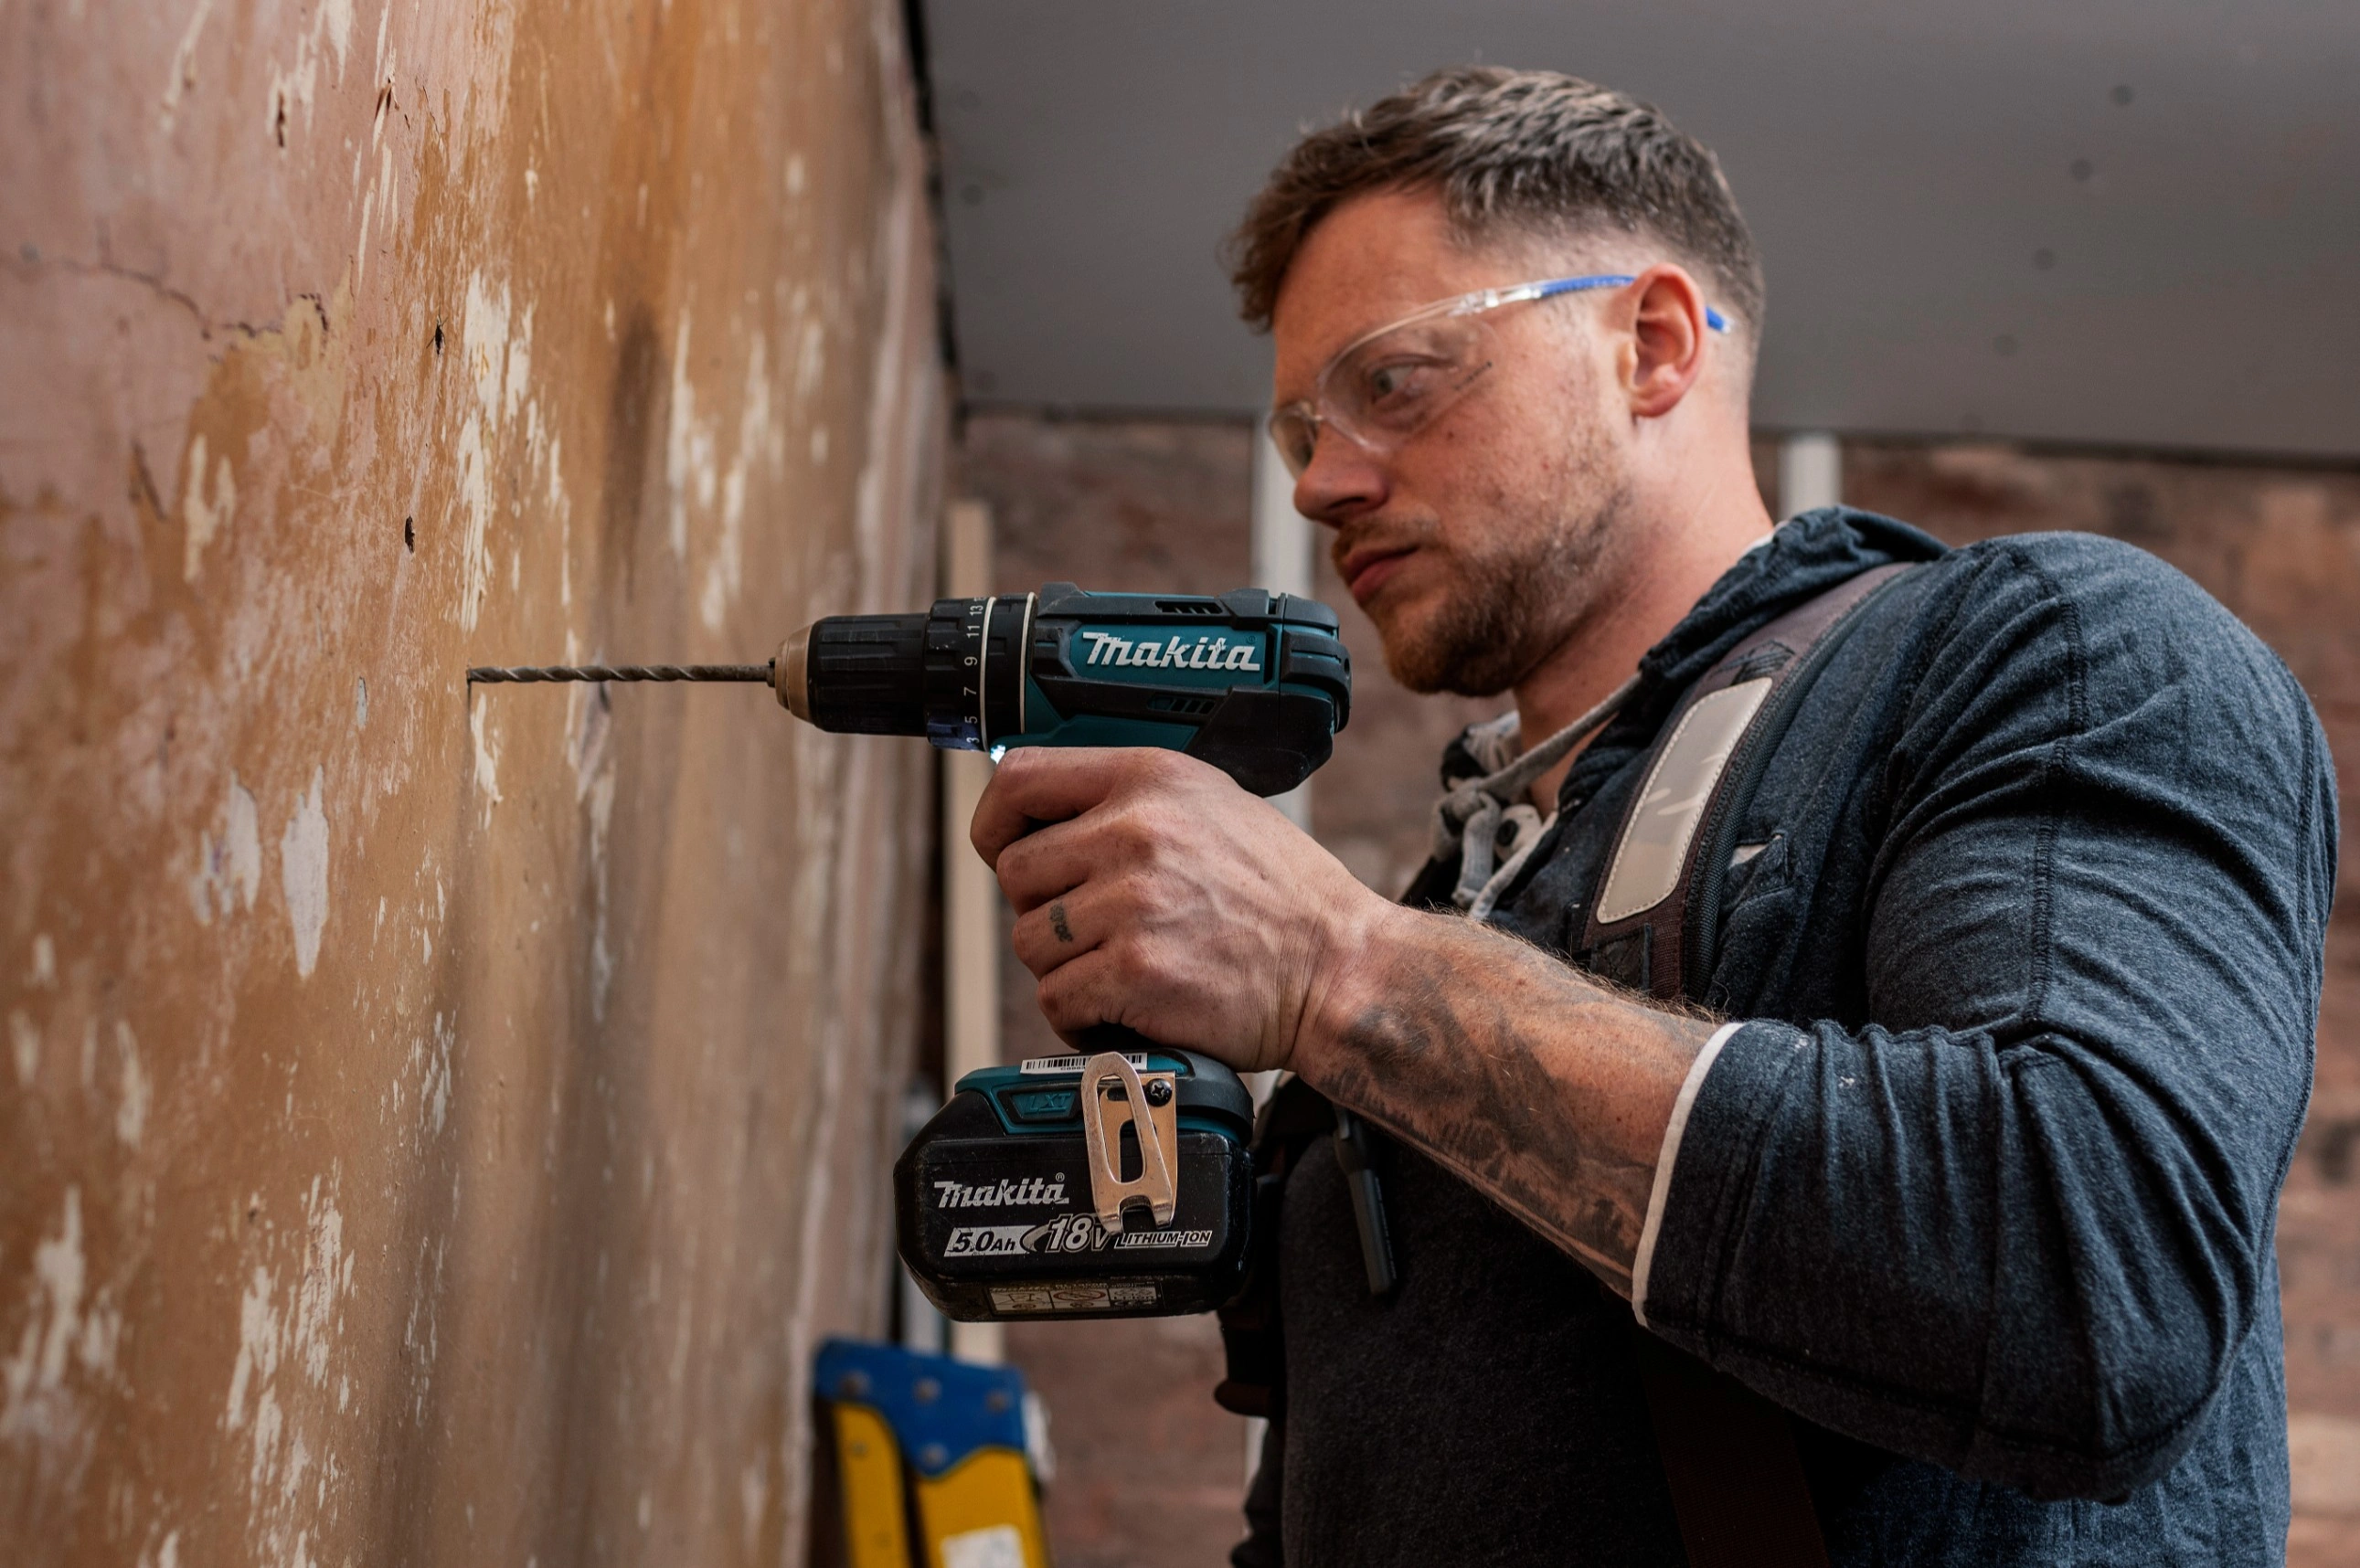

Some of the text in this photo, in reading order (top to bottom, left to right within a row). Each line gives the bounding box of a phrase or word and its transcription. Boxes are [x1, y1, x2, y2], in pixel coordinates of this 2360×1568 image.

[969, 605, 983, 617] 13
[966, 625, 981, 639] 11
[963, 656, 978, 667] 9
[963, 686, 977, 696] 7
[964, 715, 978, 725] 5
[1026, 1093, 1071, 1112] LXT
[948, 1230, 1015, 1252] 5.0Ah
